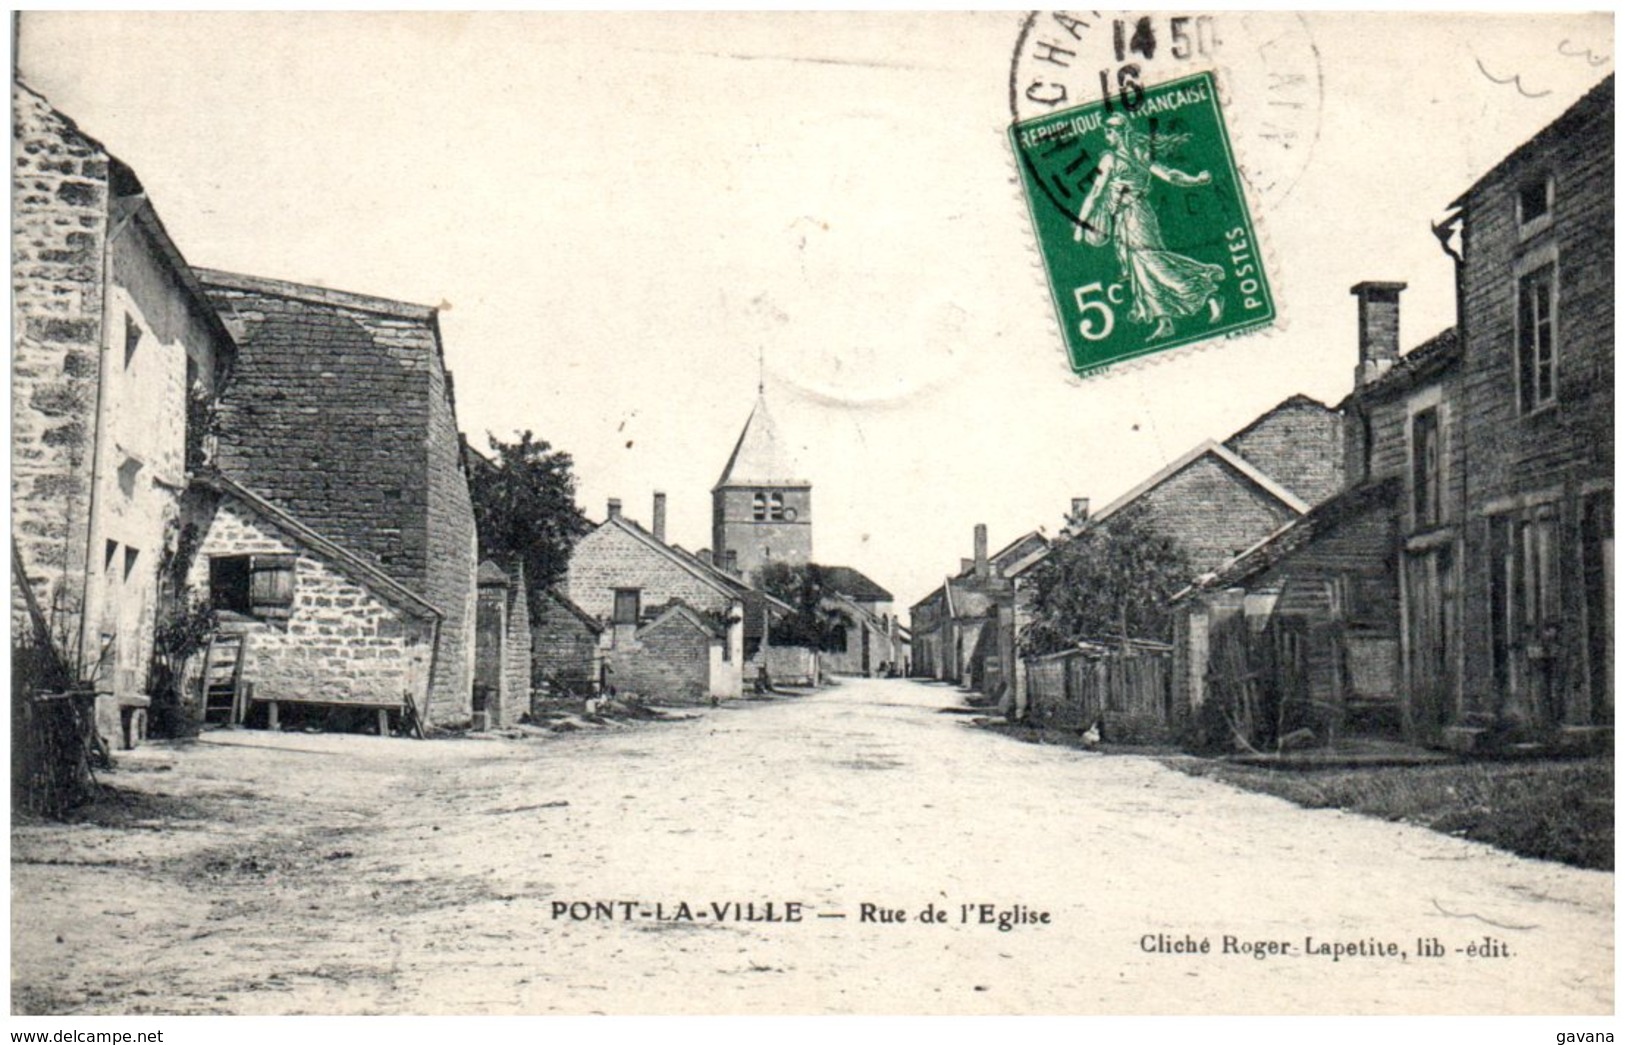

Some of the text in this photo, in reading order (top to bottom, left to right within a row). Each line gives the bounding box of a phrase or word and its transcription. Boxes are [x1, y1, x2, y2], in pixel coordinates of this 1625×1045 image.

[1225, 226, 1262, 310] POSTES
[550, 901, 804, 922] PONT-LA-VILLE
[859, 902, 907, 924] Rue
[919, 903, 948, 924] de
[960, 903, 1052, 932] l'Eglise
[1139, 933, 1211, 954] Cliché
